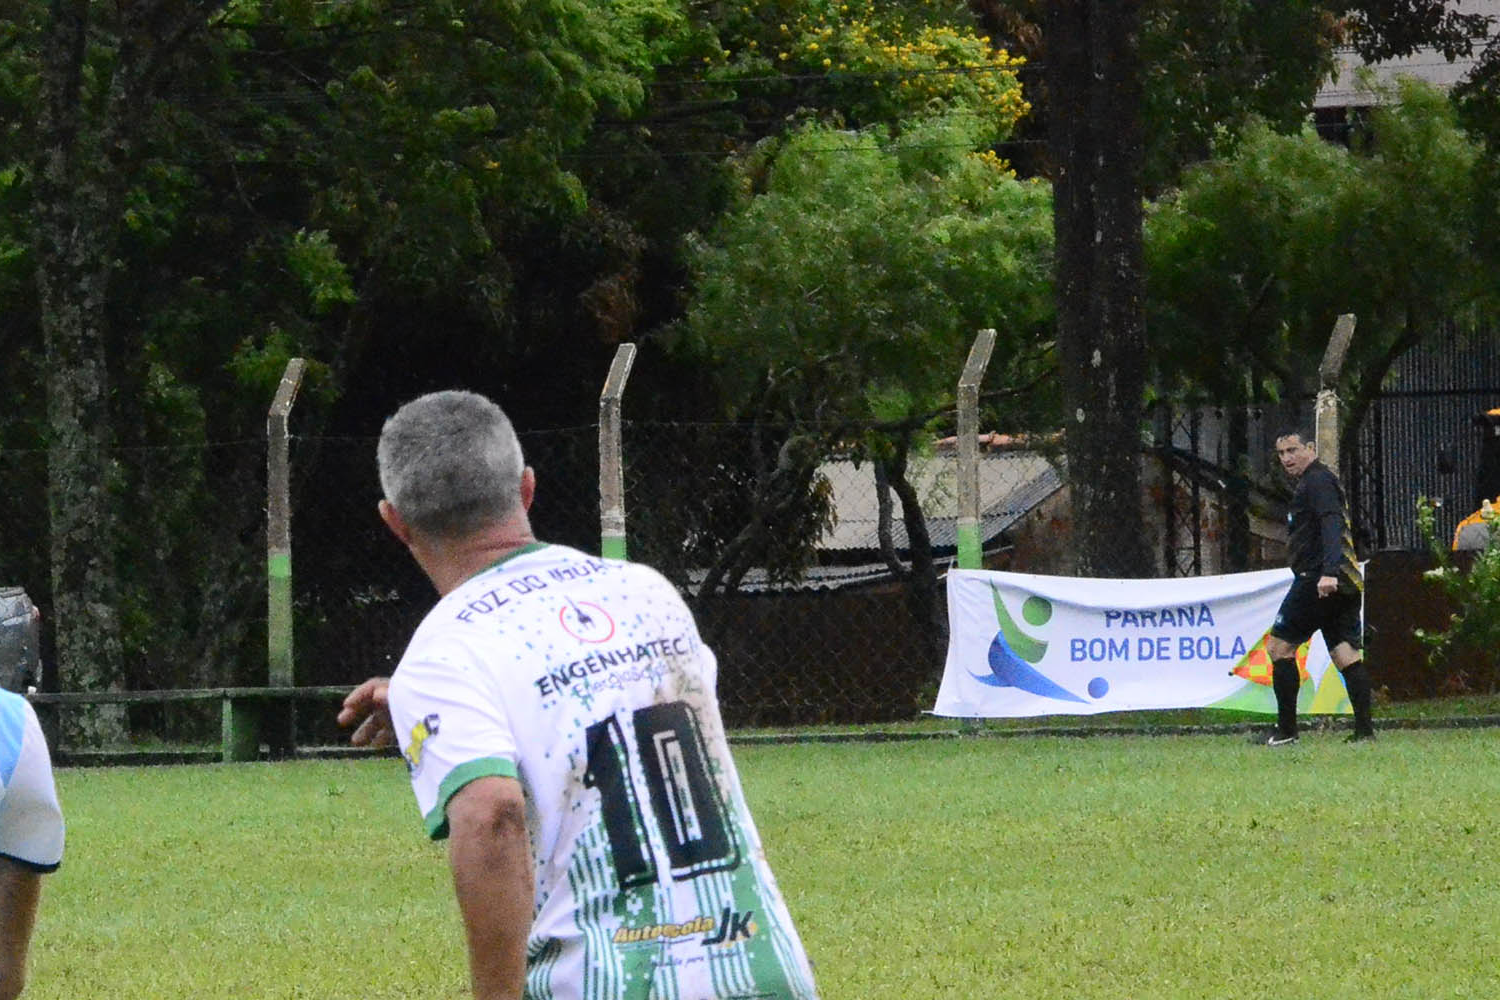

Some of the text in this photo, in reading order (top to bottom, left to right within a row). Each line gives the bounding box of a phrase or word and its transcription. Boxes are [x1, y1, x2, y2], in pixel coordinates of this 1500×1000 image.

[456, 589, 510, 624] FOZ
[507, 574, 547, 595] DO
[1069, 635, 1247, 662] BOM DE BOLA
[582, 699, 741, 889] 10
[699, 907, 754, 947] JK
